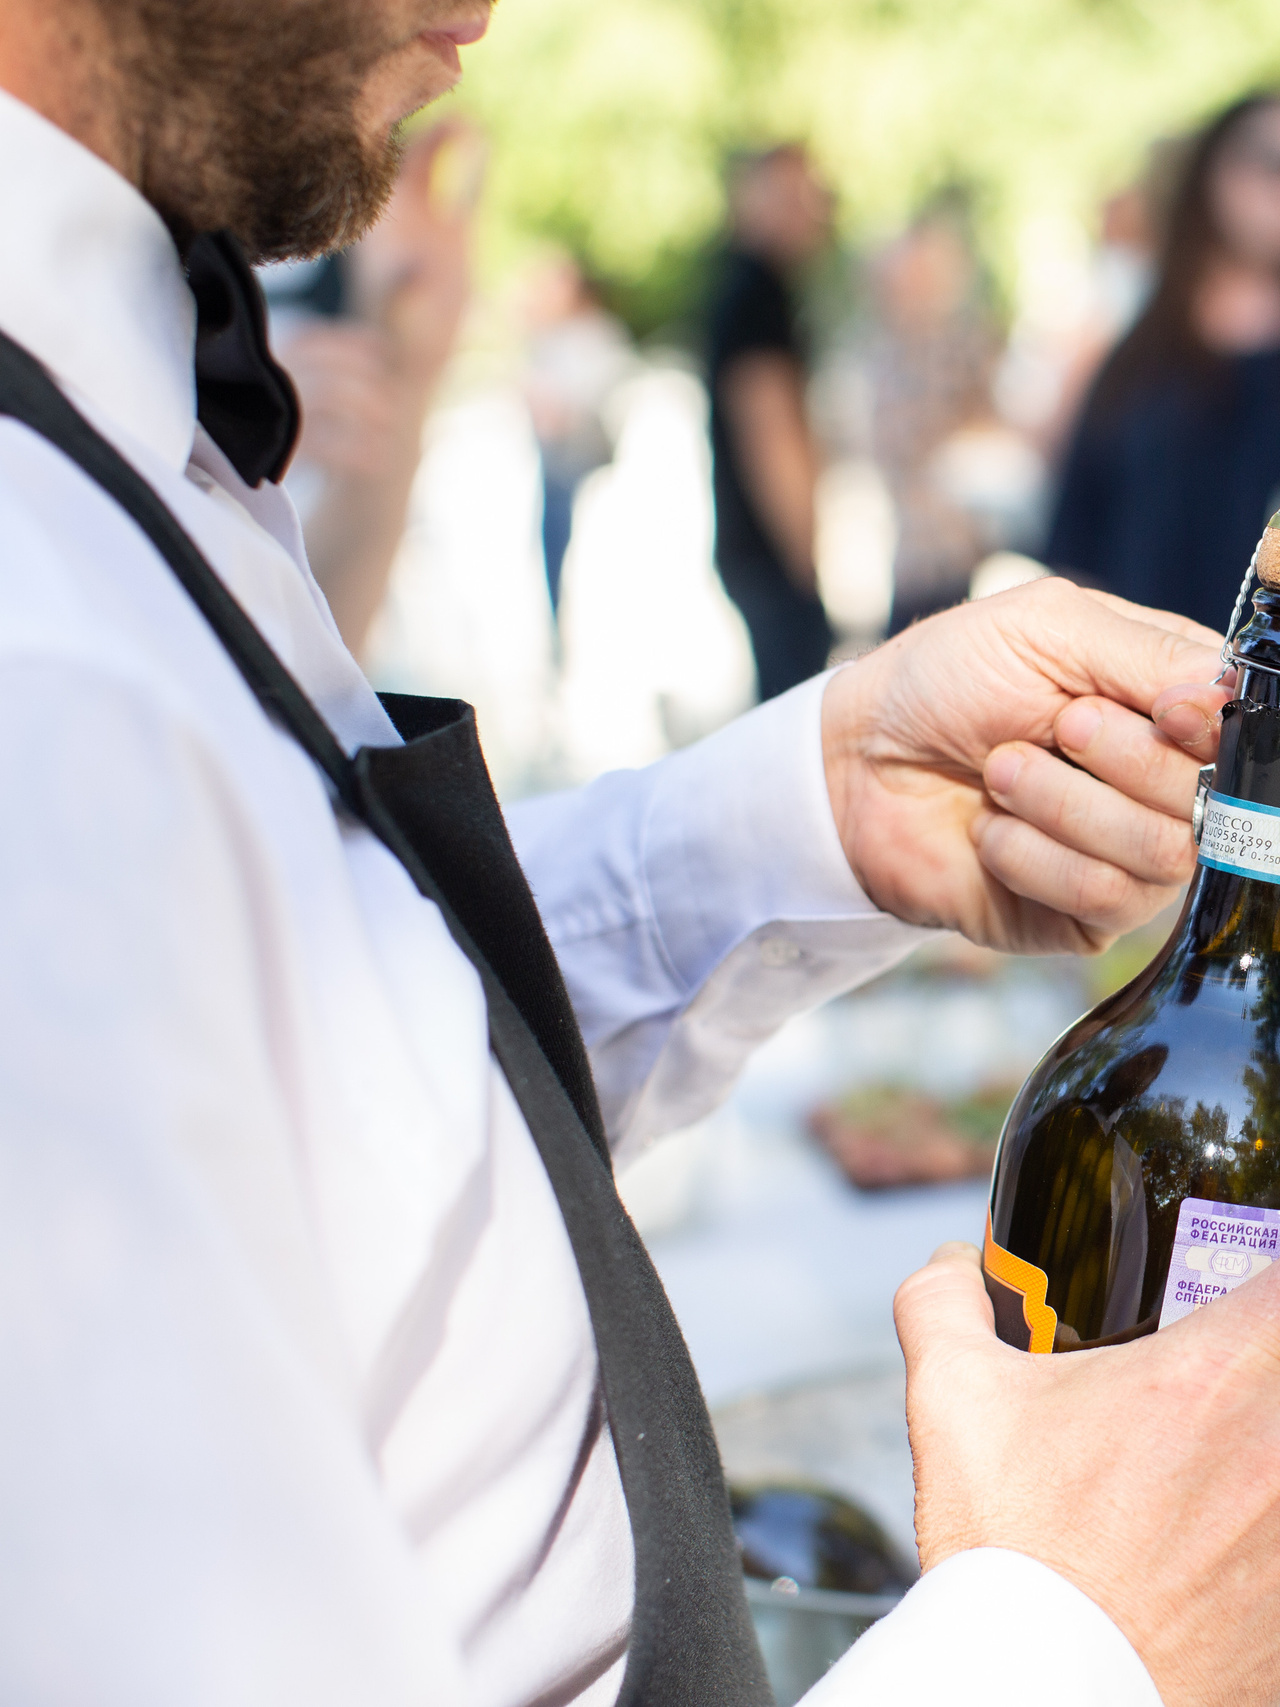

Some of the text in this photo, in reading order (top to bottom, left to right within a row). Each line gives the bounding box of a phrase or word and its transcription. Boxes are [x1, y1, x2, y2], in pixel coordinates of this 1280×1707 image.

[1250, 851, 1280, 865] 0.750
[1191, 1217, 1279, 1239] РОССИЙСКАЯ
[1190, 1229, 1277, 1249] ФЕДЕРАЦИЯ
[1177, 1280, 1234, 1296] ФЕДЕРА
